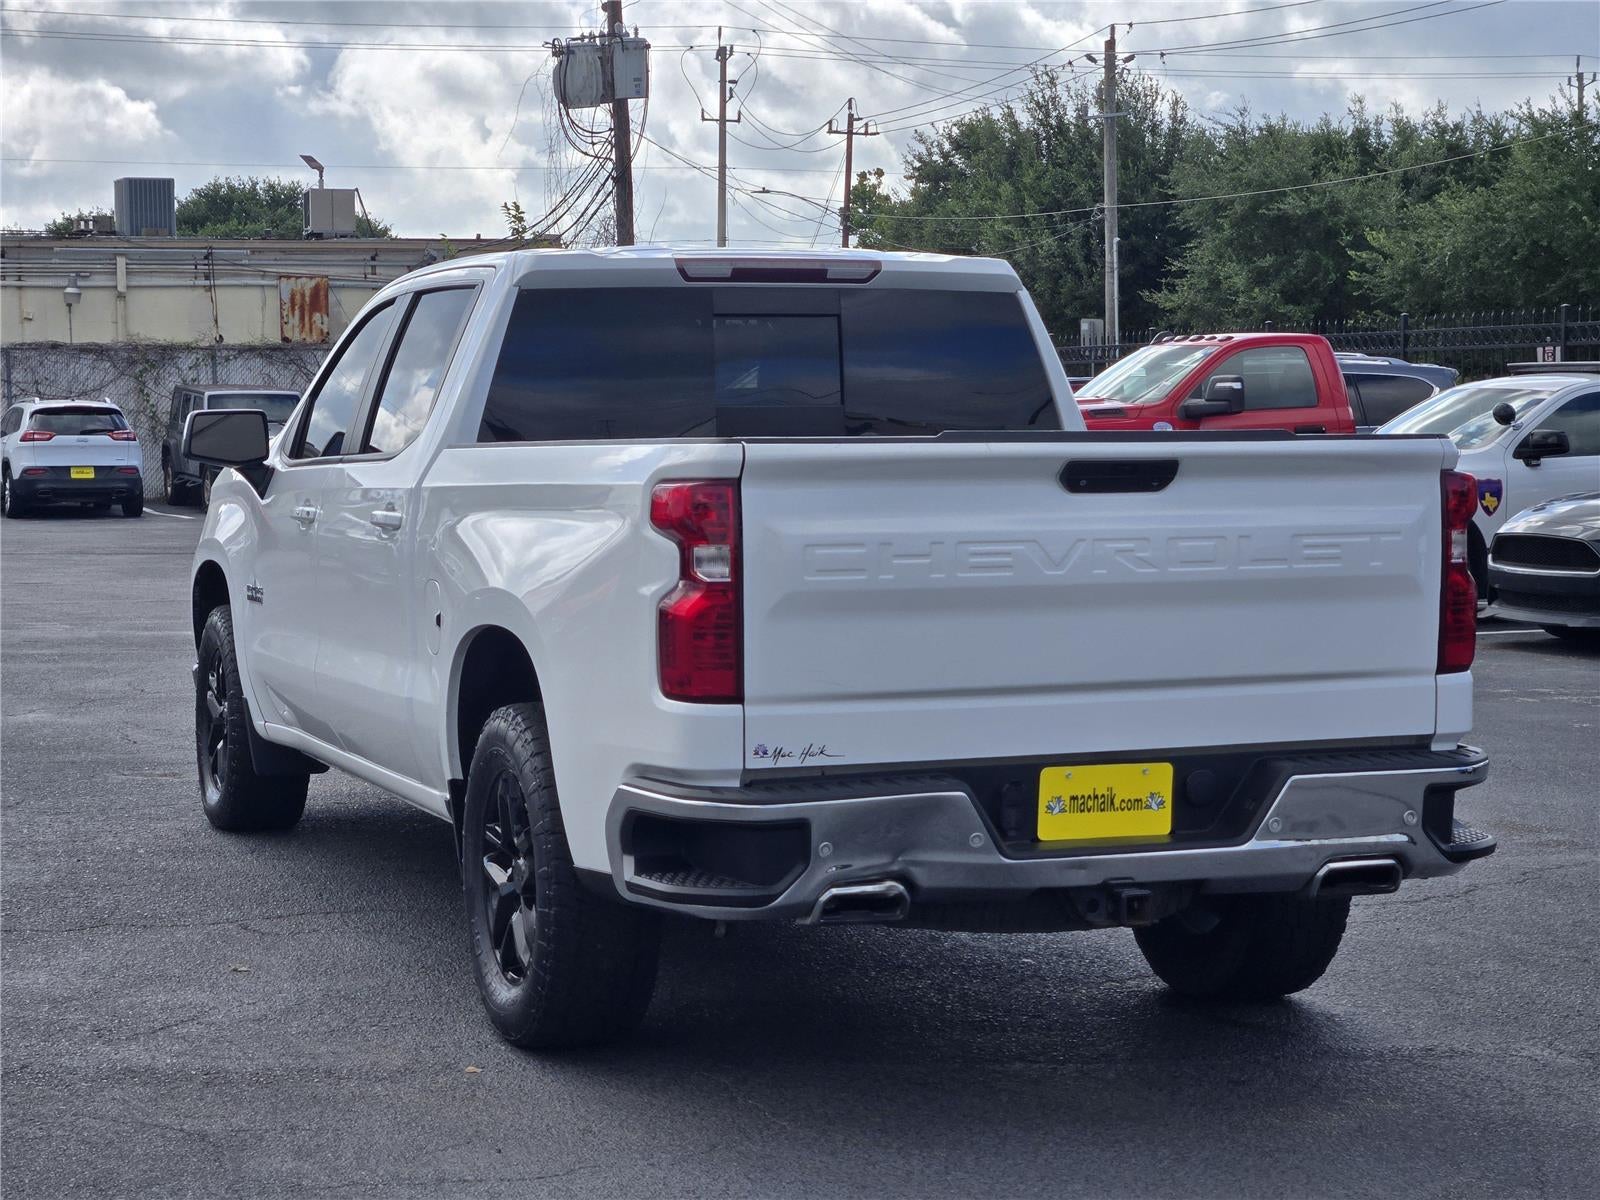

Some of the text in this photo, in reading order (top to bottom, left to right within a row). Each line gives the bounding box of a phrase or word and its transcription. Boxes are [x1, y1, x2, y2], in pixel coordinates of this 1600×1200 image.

[803, 530, 1402, 581] CHEVROLET
[769, 742, 845, 766] Mac Haik
[1068, 786, 1143, 814] machaik.com
